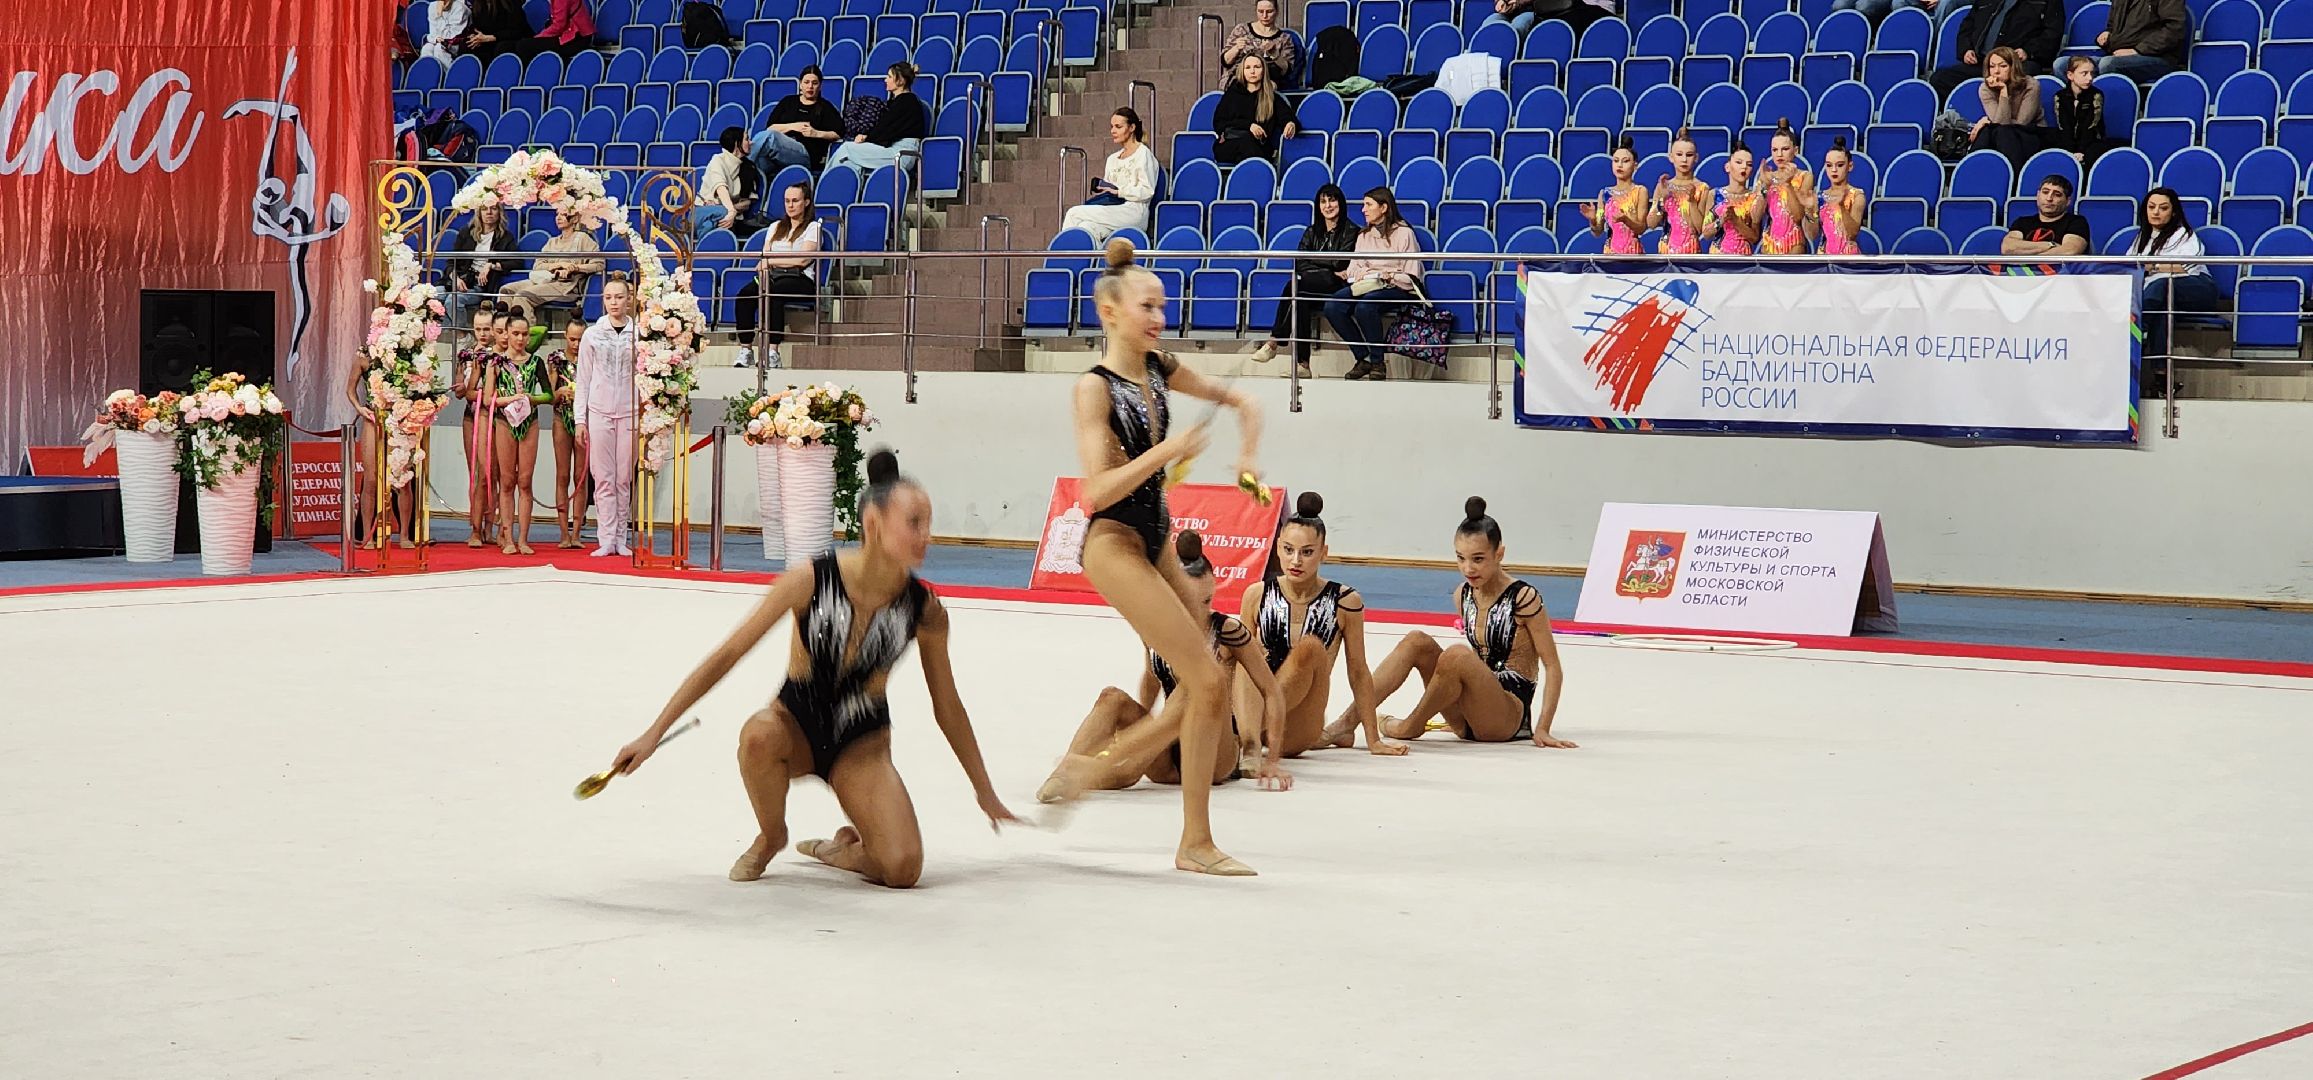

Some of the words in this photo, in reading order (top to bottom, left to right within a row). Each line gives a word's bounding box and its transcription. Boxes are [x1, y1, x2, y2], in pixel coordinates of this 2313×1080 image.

[1702, 333, 1908, 360] НАЦИОНАЛЬНАЯ
[1915, 334, 2068, 364] ФЕДЕРАЦИЯ
[1702, 359, 1875, 386] БАДМИНТОНА
[1701, 386, 1797, 410] РОССИИ
[1697, 528, 1813, 543] МИНИСТЕРСТВО
[1693, 545, 1790, 559] ФИЗИЧЕСКОЙ
[1689, 560, 1762, 575] КУЛЬТУРЫ
[1765, 563, 1776, 575] И
[1780, 565, 1837, 578] СПОРТА
[1685, 577, 1784, 592] МОСКОВСКОЙ
[1682, 593, 1748, 607] ОБЛАСТИ
